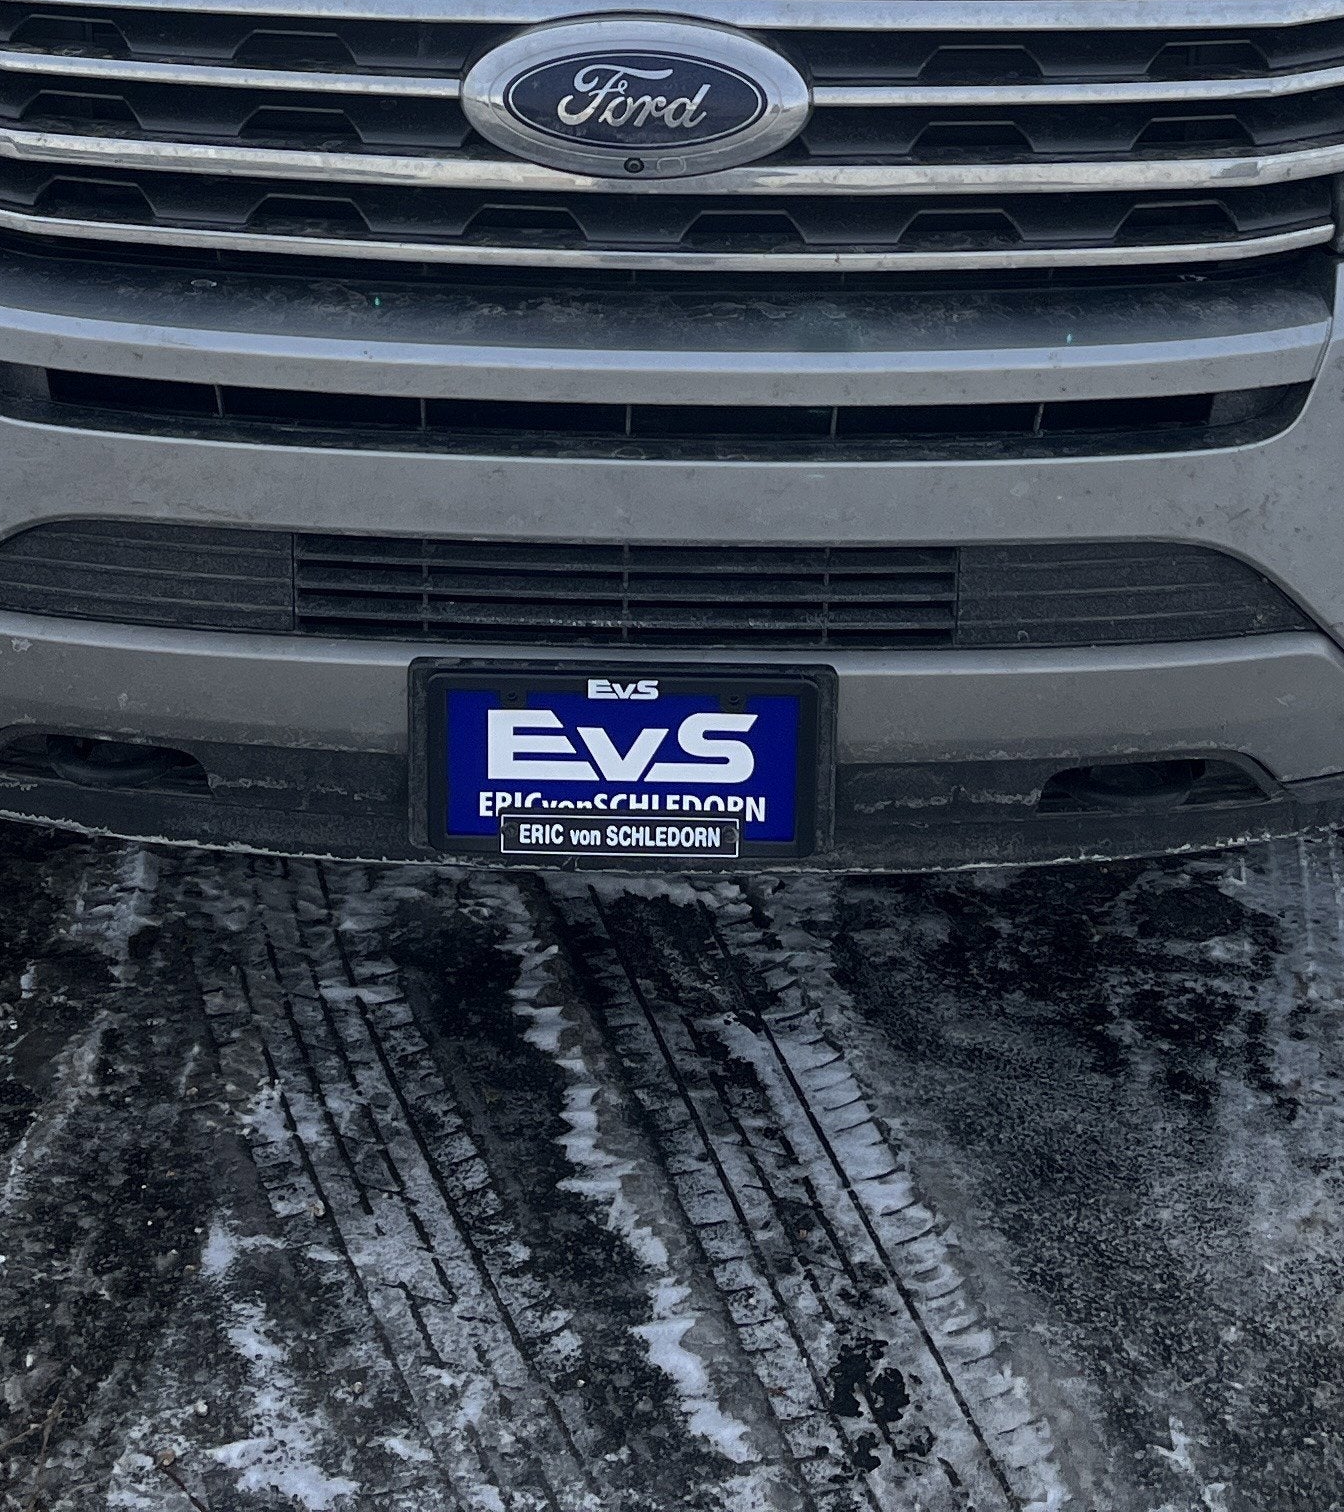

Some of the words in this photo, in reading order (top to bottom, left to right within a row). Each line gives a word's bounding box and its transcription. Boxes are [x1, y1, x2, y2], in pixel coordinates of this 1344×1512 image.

[557, 63, 712, 129] Ford
[519, 823, 564, 845] ERIC
[570, 829, 602, 846] von
[606, 825, 721, 848] SCHLEDORN
